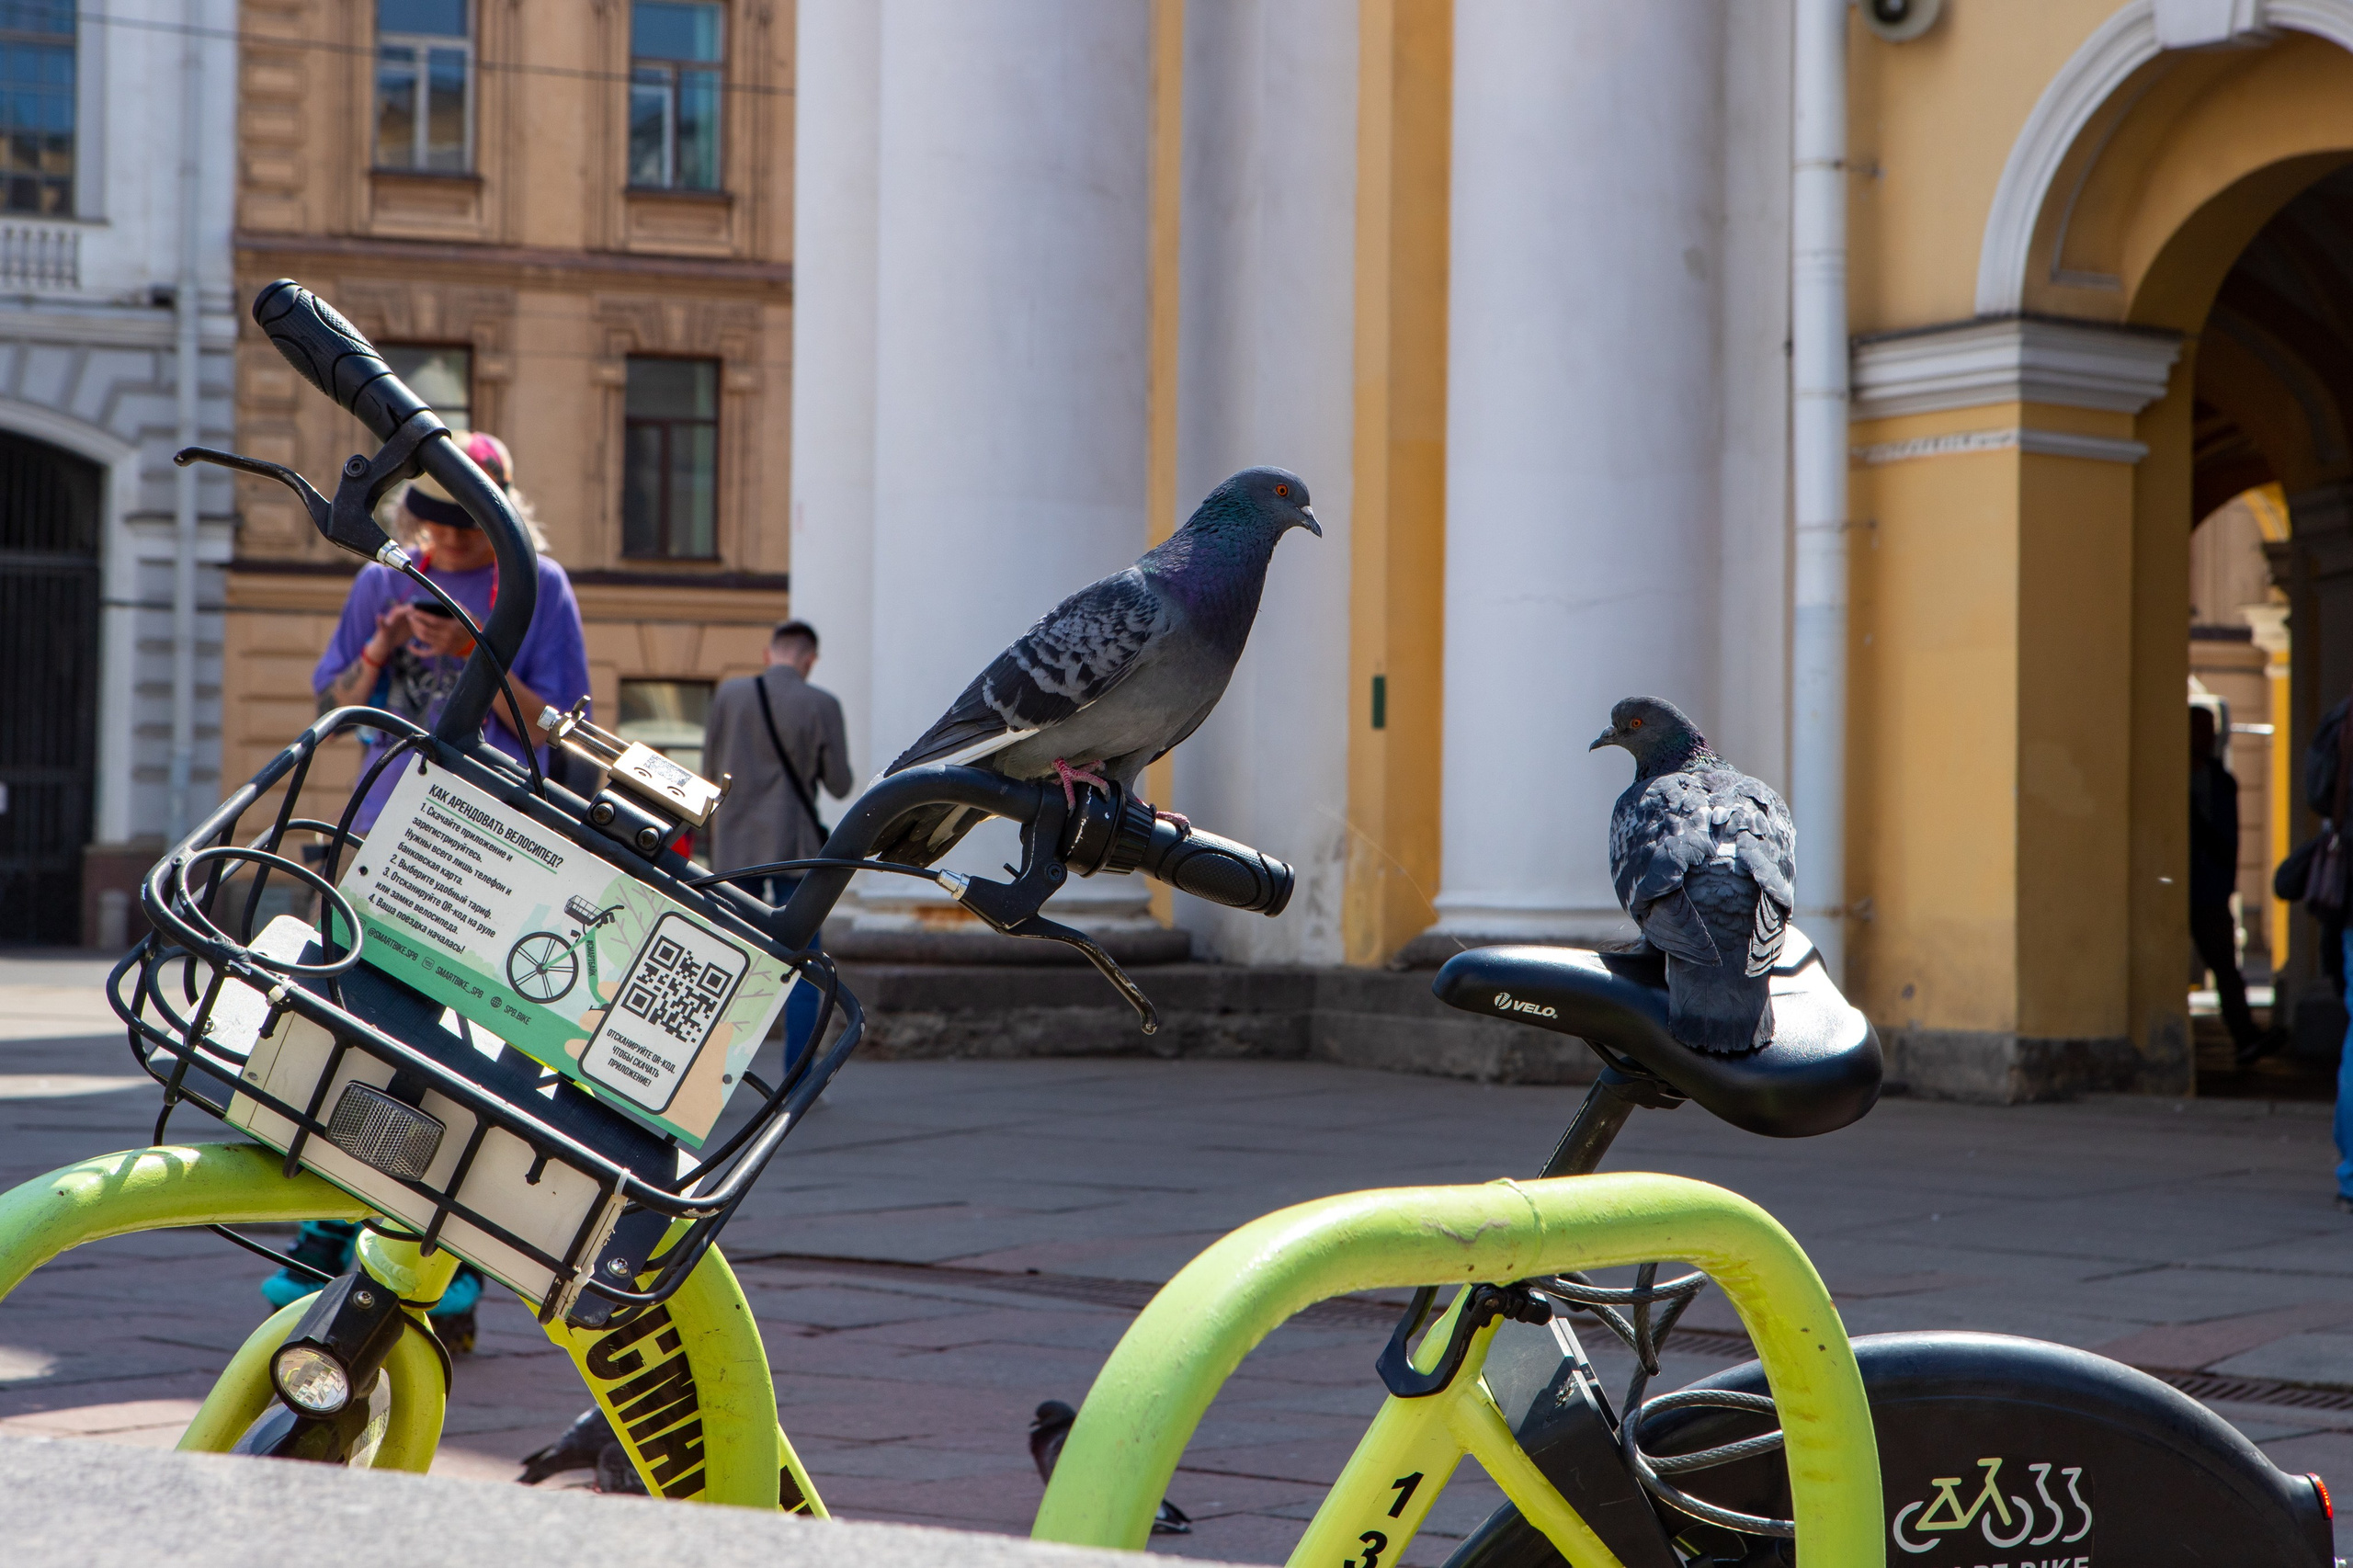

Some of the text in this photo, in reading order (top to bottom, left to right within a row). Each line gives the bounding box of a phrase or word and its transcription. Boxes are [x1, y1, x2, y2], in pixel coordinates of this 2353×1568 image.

[412, 817, 482, 863] зарегистрируйтесь.
[420, 802, 513, 862] 1. Скачайте приложение и
[428, 784, 563, 868] КАК АРЕНДОВАТЬ ВЕЛОСИПЕД?
[390, 854, 491, 919] 2. Выберите удобный тариф.
[397, 842, 462, 886] банковская карта.
[404, 828, 512, 896] Нужны всего лишь телефон и
[368, 893, 466, 954] 4. Ваша поездка началась!
[375, 881, 458, 935] или замке велосипеда.
[382, 867, 495, 937] 3. Отсканируйте QR-код на руле
[504, 1005, 531, 1026] SPB.BIKE
[607, 1028, 654, 1060] ОТСКАНИРУЙТЕ
[612, 1045, 659, 1078] ЧТОБЫ СКАЧАТЬ
[608, 1058, 652, 1087] ПРИЛОЖЕНИЕ!
